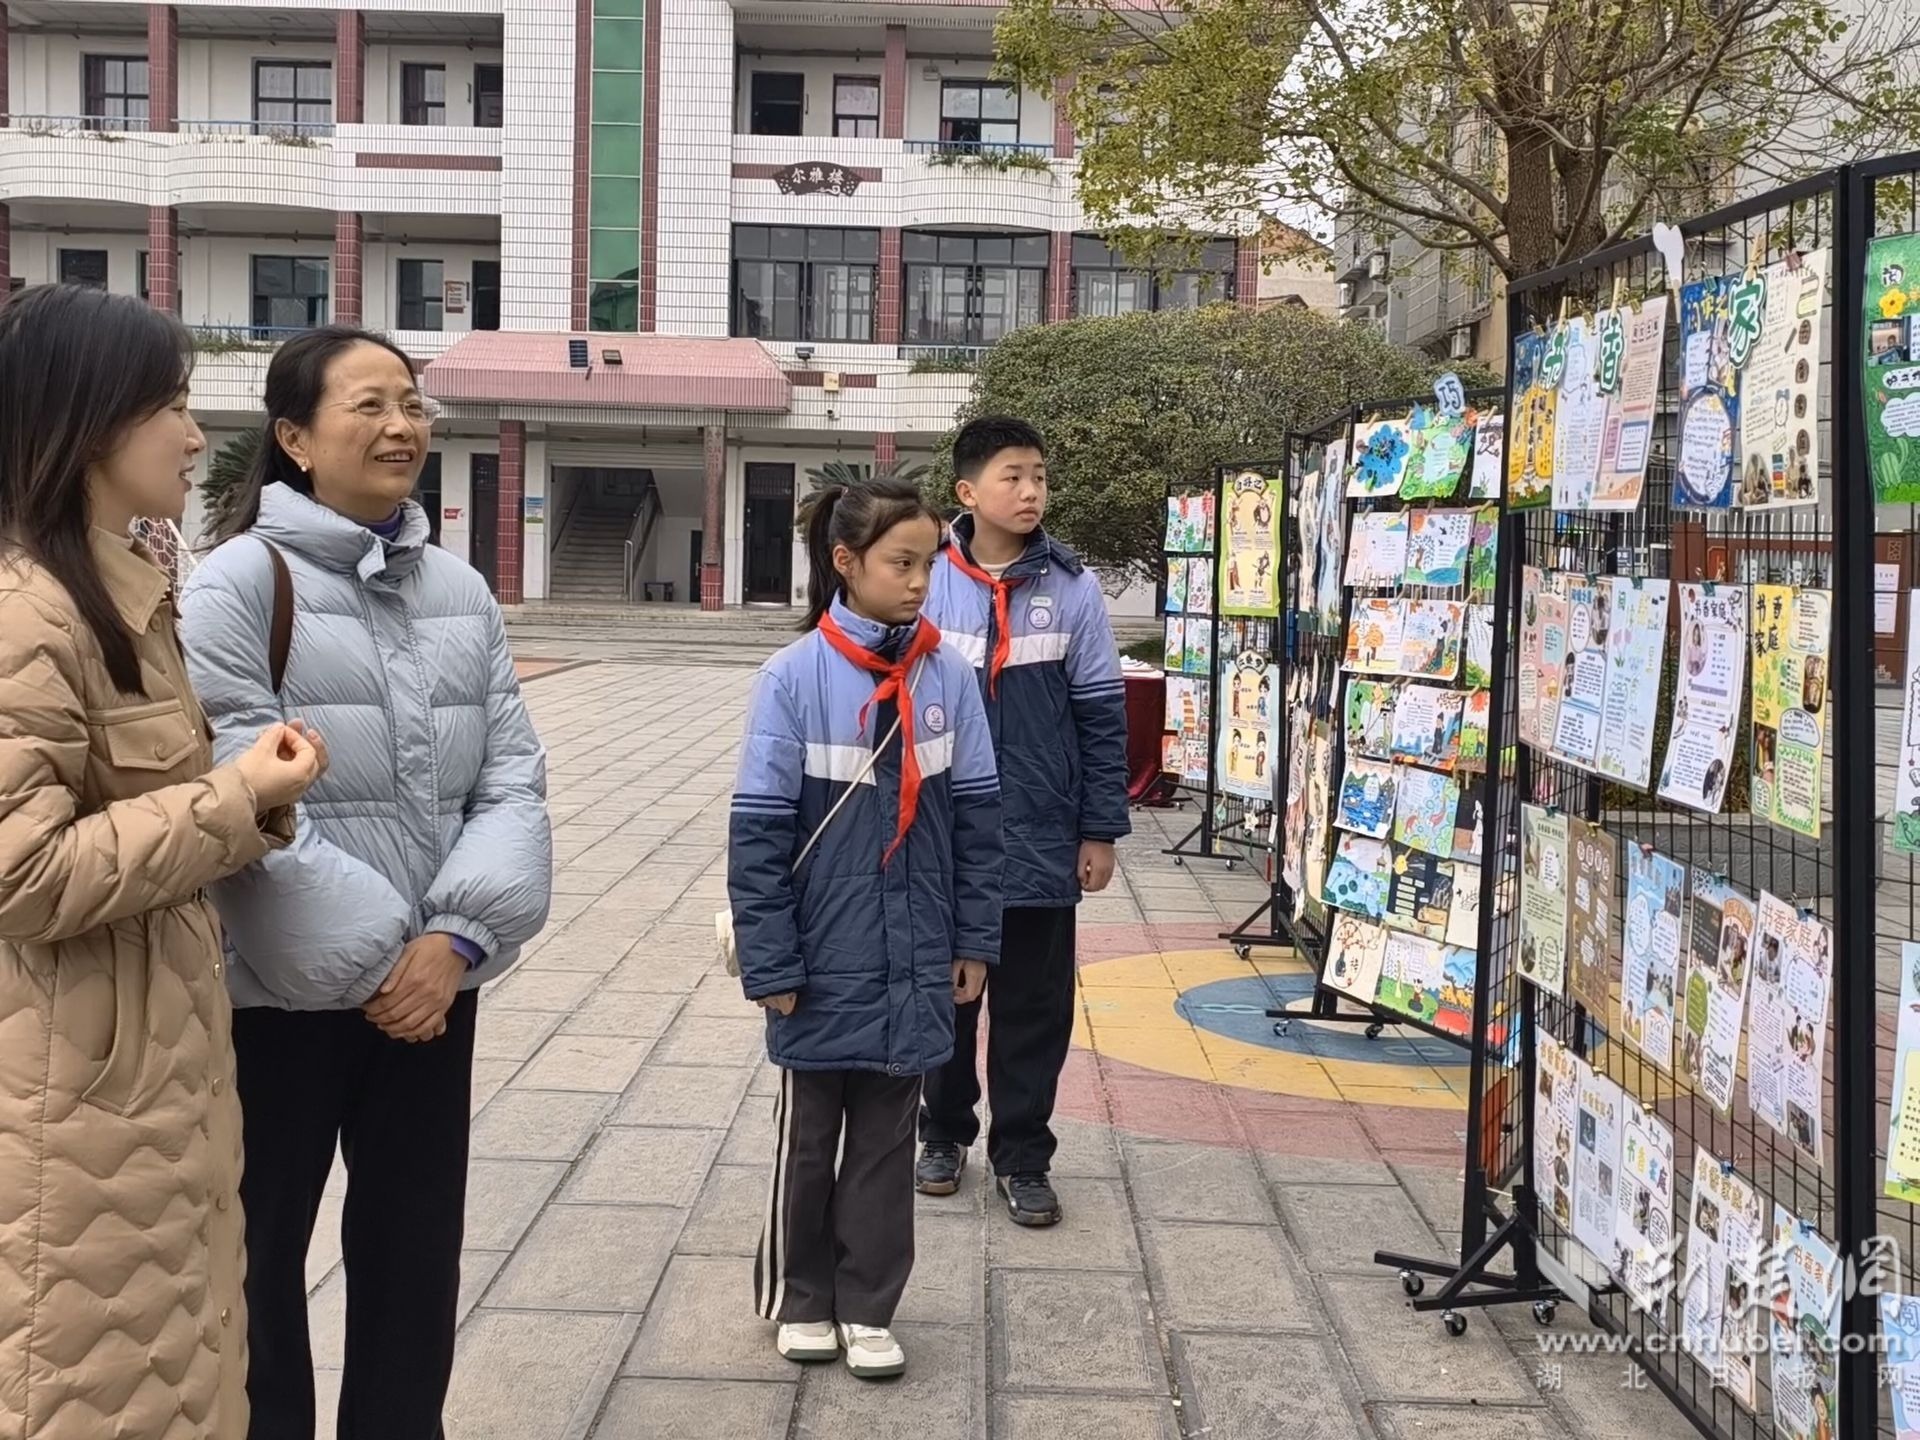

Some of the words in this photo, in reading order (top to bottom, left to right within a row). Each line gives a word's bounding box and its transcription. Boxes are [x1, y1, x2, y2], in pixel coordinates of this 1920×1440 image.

[791, 167, 845, 185] 尔雅楼
[1730, 278, 1761, 360] 家
[1601, 316, 1622, 390] 香
[1694, 599, 1727, 621] 书香家庭
[1756, 593, 1783, 627] 书香
[1753, 625, 1780, 658] 家庭
[1762, 900, 1812, 952] 书香家庭
[1627, 1135, 1668, 1196] 书香家庭
